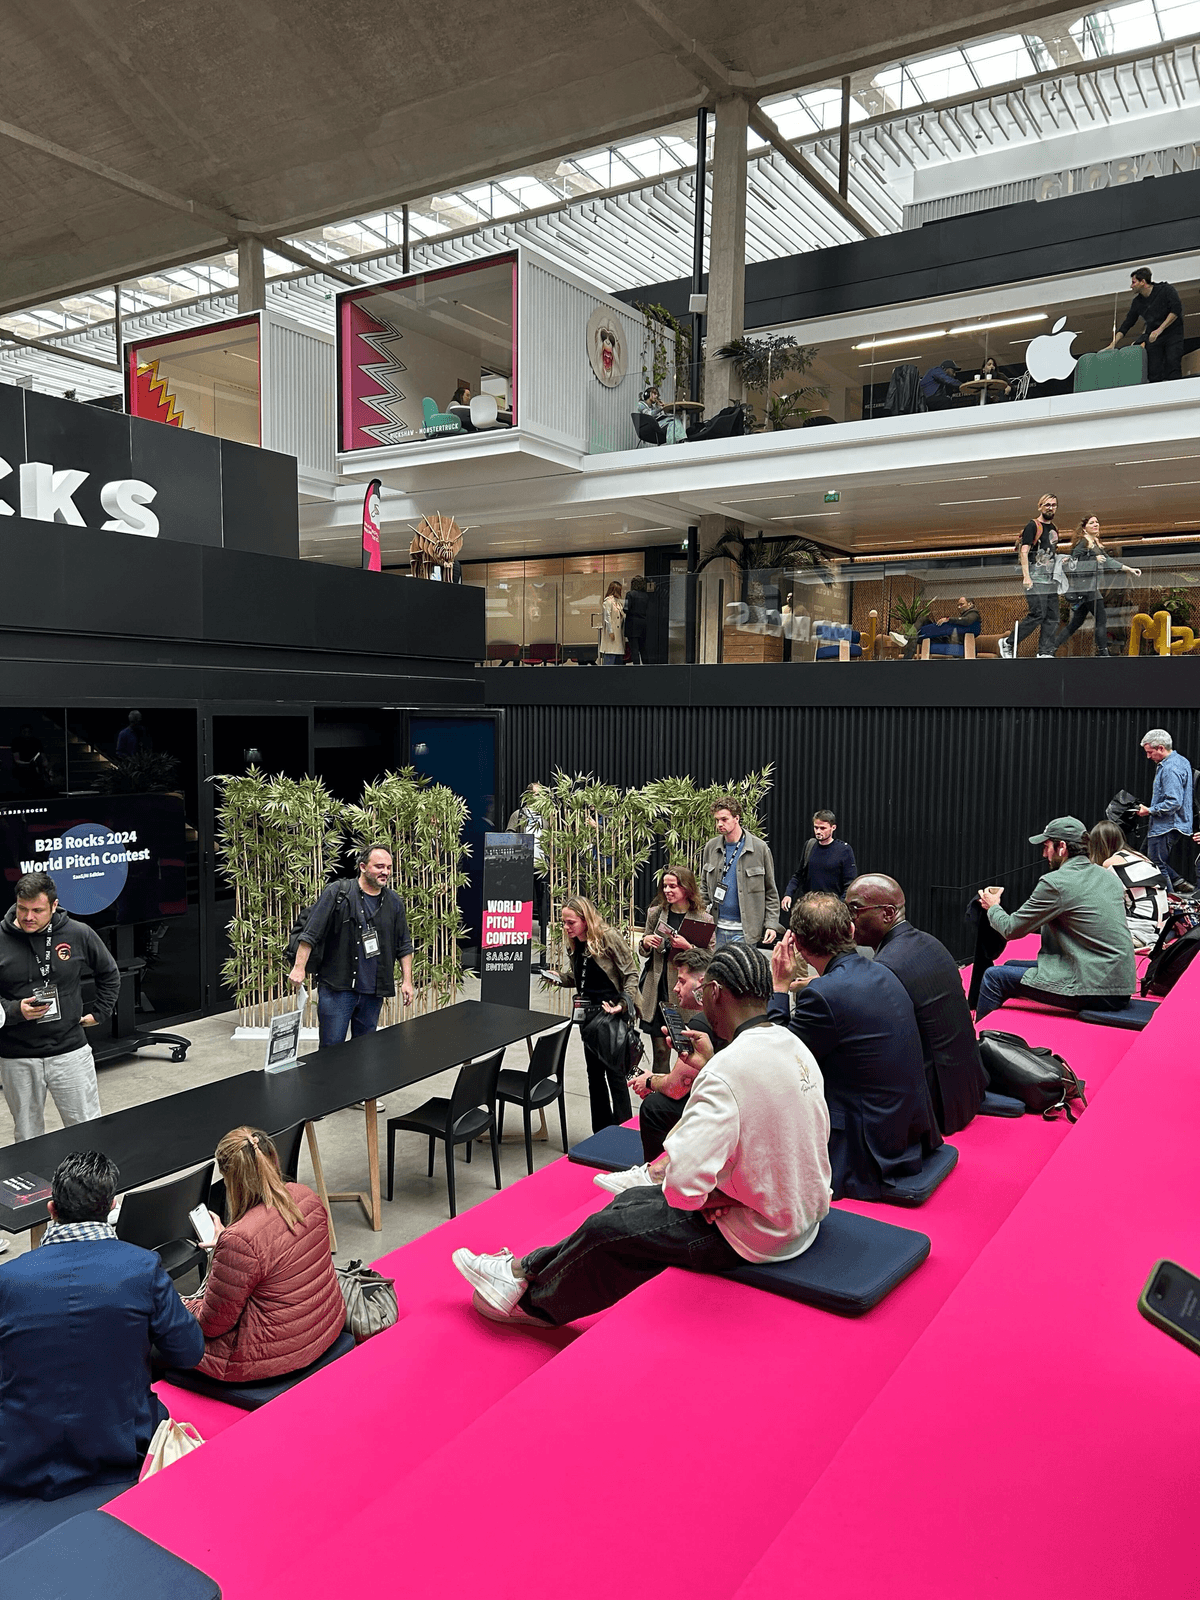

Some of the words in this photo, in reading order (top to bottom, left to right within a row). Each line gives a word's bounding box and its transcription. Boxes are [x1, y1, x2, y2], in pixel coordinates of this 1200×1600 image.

[1035, 142, 1200, 202] GLOBAN
[419, 423, 459, 434] MONSTERTRUCK
[35, 837, 63, 852] B2B
[65, 833, 105, 849] Rocks
[106, 831, 137, 845] 2024
[20, 857, 63, 874] World
[66, 853, 100, 869] Pitch
[102, 848, 150, 864] Contest
[487, 900, 522, 913] WORLD
[486, 916, 515, 929] PITCH
[486, 931, 529, 945] CONTEST
[485, 951, 523, 961] SAAS/AI
[485, 963, 514, 971] EDITION
